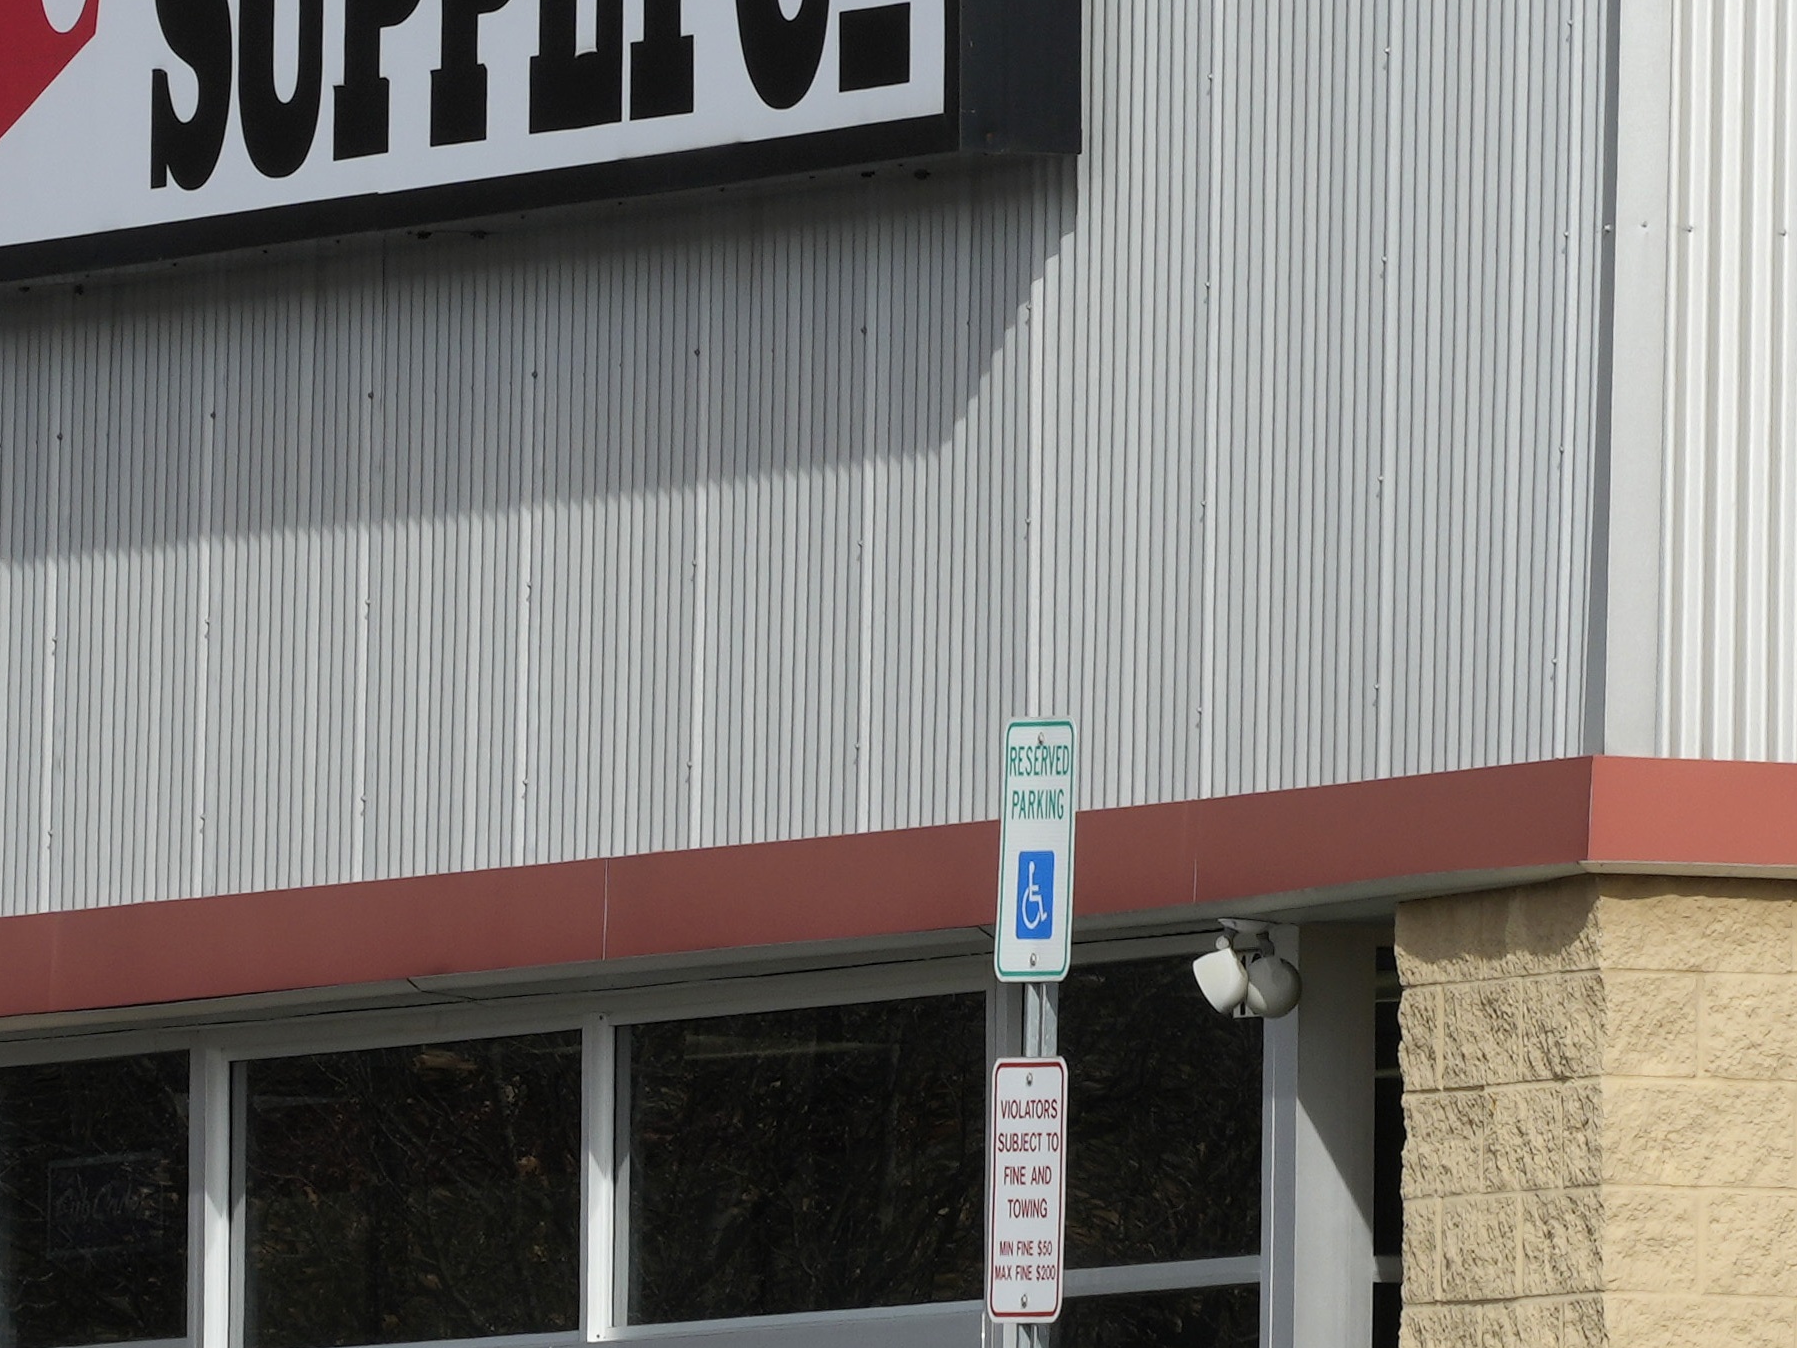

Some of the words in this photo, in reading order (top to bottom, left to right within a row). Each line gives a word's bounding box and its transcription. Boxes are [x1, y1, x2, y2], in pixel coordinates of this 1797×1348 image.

[1009, 745, 1070, 776] RESERVED
[1011, 789, 1064, 821] PARKING
[1000, 1099, 1058, 1120] VIOLATORS
[997, 1133, 1042, 1153] SUBJECT
[1045, 1132, 1059, 1153] TO
[1004, 1166, 1028, 1186] FINE
[1030, 1166, 1052, 1185] AND
[1007, 1198, 1048, 1219] TOWING
[999, 1240, 1014, 1257] MIN
[1016, 1240, 1034, 1257] FINE
[1037, 1240, 1053, 1258] $50
[994, 1265, 1012, 1281] MAX
[1015, 1265, 1033, 1281] FINE
[1035, 1264, 1056, 1282] $200
